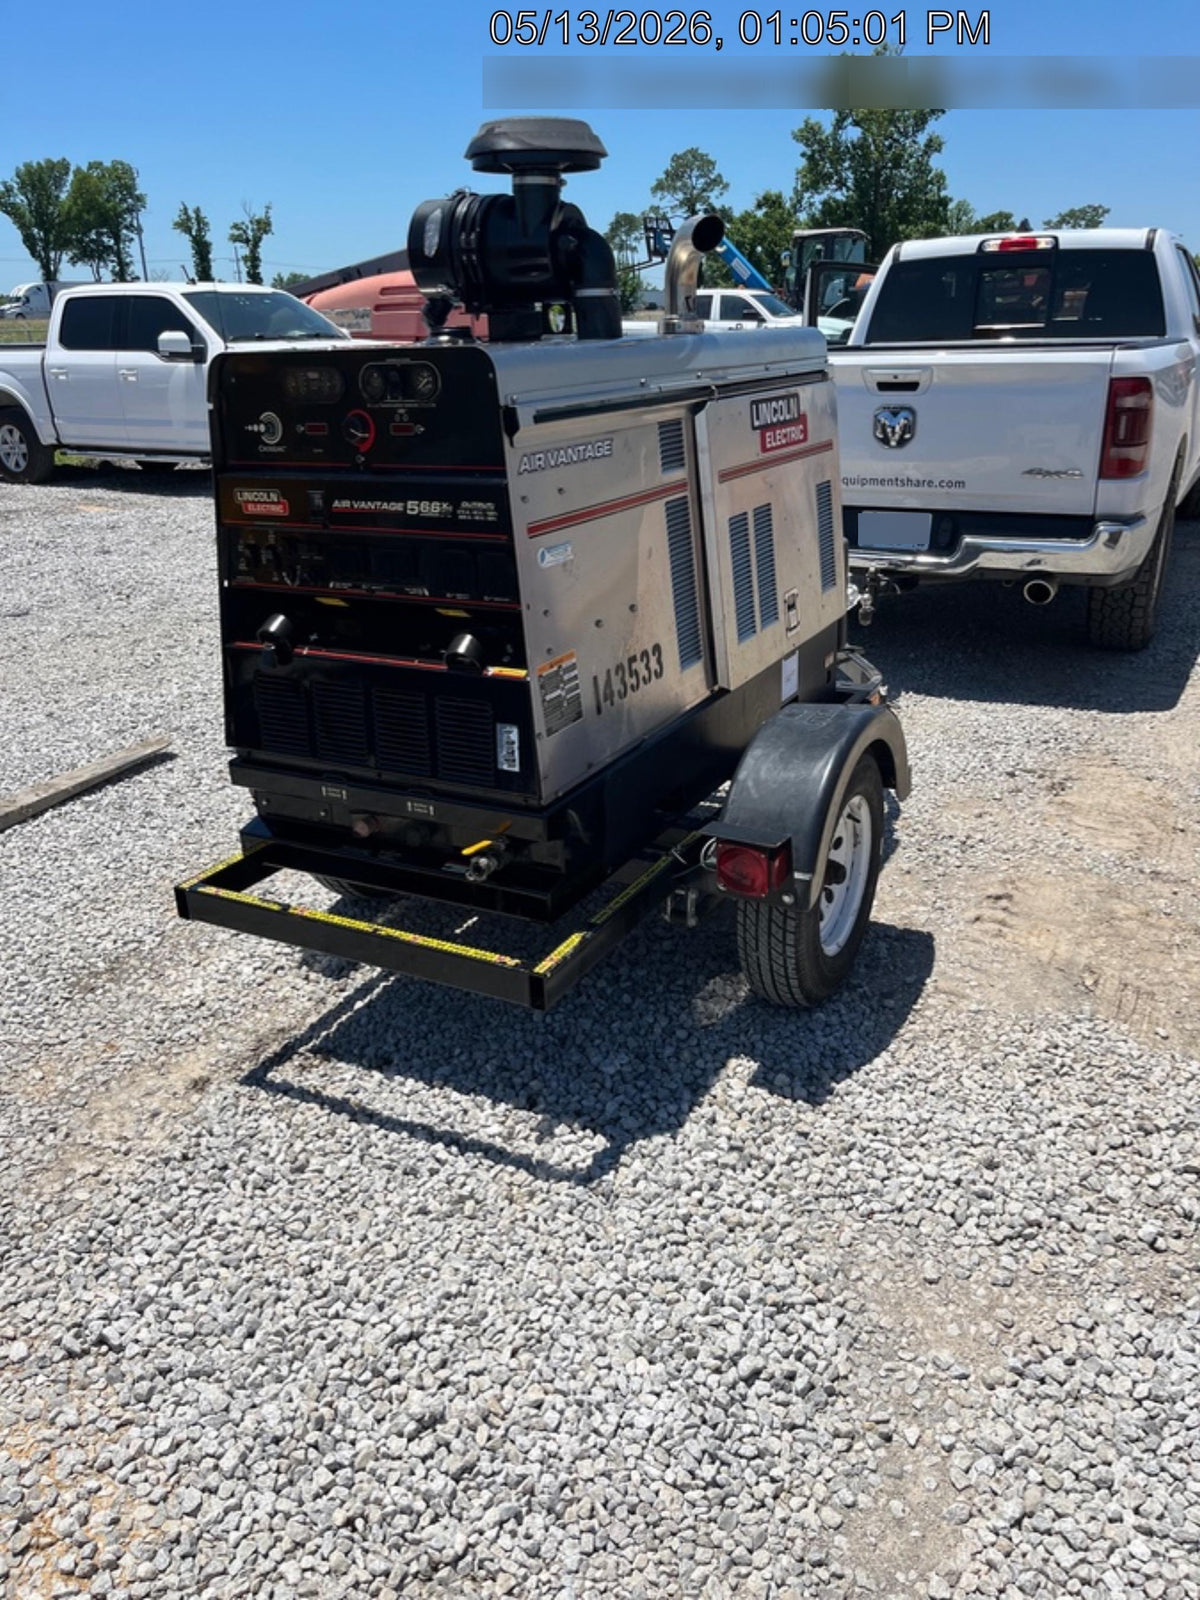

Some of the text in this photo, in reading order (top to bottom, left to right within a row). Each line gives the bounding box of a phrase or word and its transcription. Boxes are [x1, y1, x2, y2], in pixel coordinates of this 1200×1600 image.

[752, 397, 798, 427] LINCOLN
[766, 425, 804, 449] ELECTRIC
[518, 438, 614, 475] AIR VANTAGE
[842, 475, 966, 488] quipmentshare.com
[237, 491, 278, 502] LINCOLN
[331, 500, 351, 509] AIR
[352, 501, 405, 511] VANTAGE
[246, 502, 285, 513] ELECTRIC
[593, 643, 664, 715] 143533
